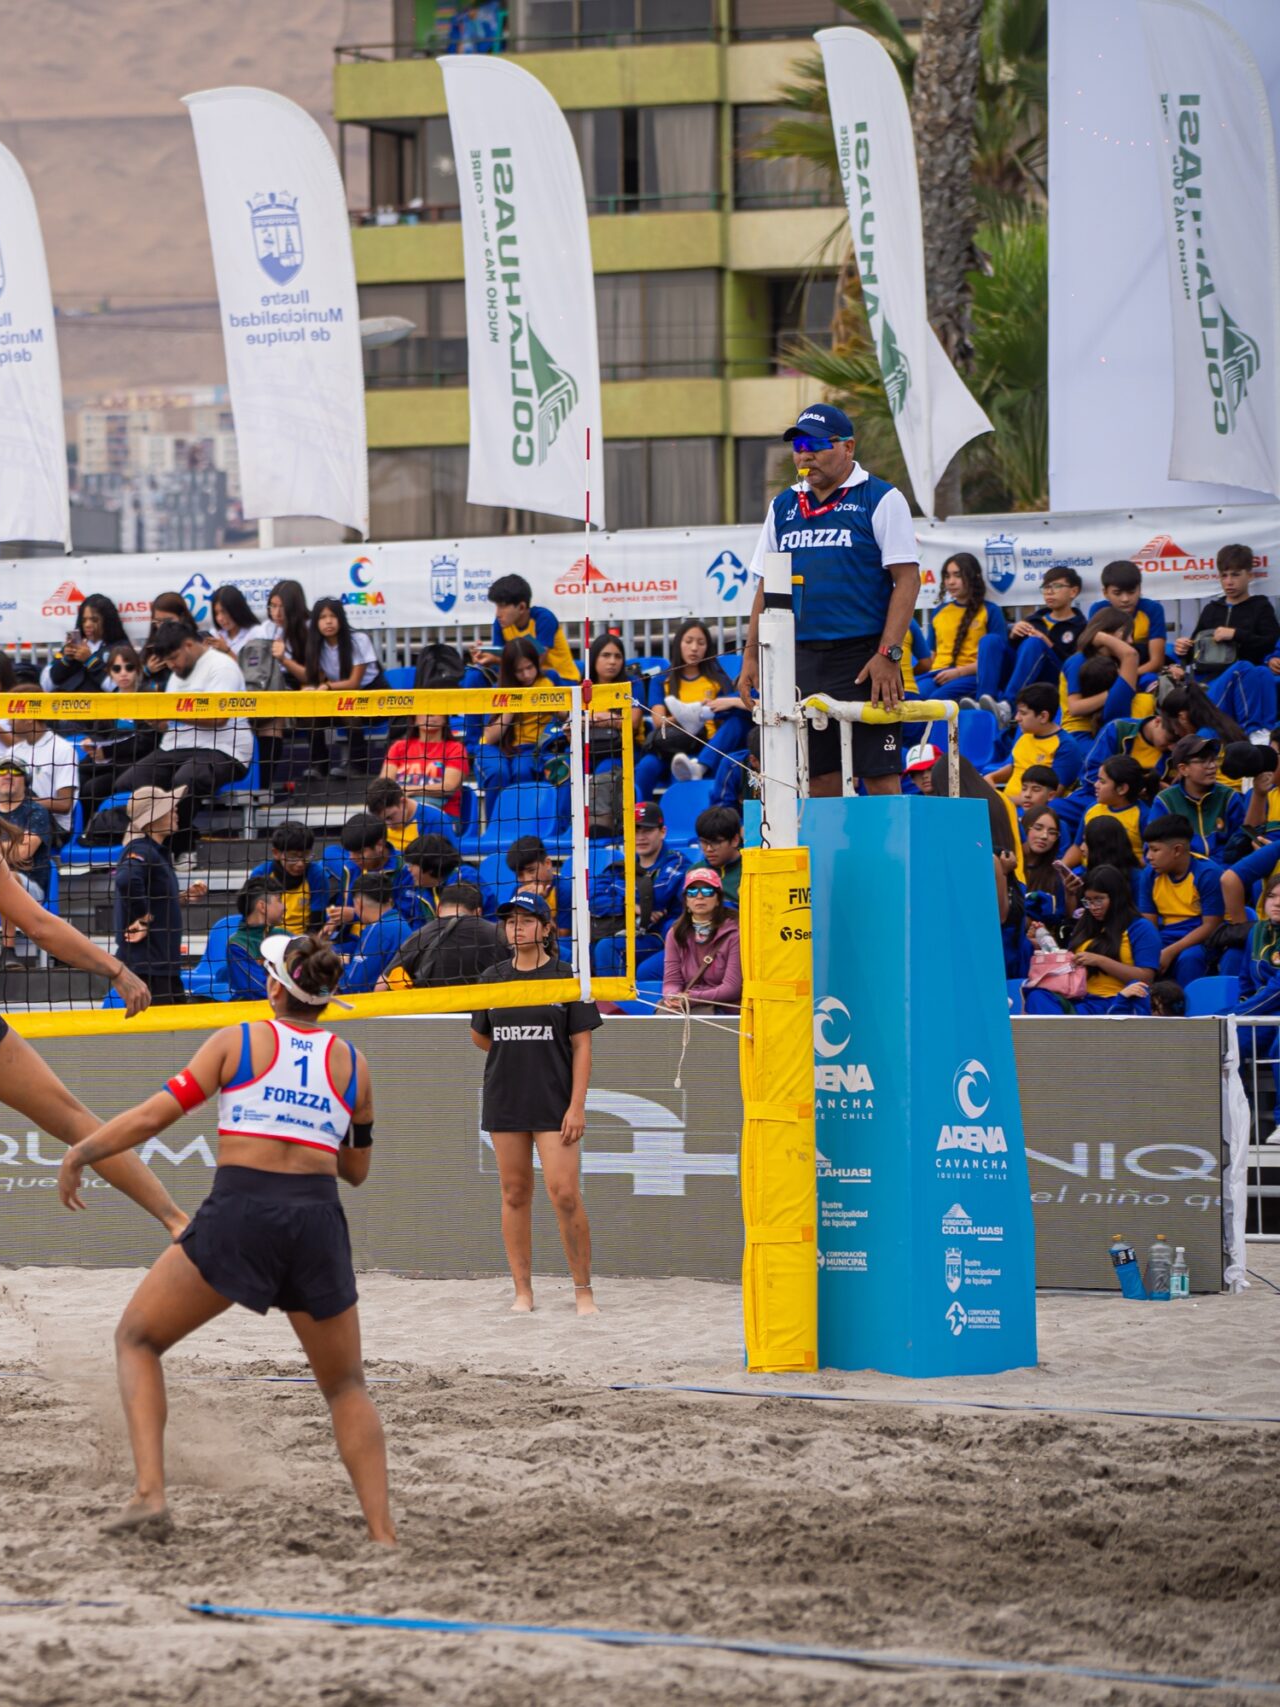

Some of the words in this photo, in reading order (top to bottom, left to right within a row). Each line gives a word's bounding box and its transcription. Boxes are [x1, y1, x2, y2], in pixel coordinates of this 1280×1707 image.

[779, 528, 853, 552] FORZZA
[1022, 547, 1053, 557] Ilustre
[1136, 556, 1269, 573] COLLAHSI
[1024, 573, 1036, 582] de
[7, 699, 28, 714] UK
[176, 697, 195, 712] UK
[337, 696, 356, 711] UK
[492, 693, 509, 707] UK
[789, 887, 811, 904] FIV
[493, 1025, 554, 1042] FORZZA
[291, 1037, 313, 1052] PAR
[294, 1055, 309, 1088] 1
[263, 1086, 332, 1114] FORZZA
[816, 1098, 874, 1109] ANCHA
[842, 1112, 873, 1120] CHILE
[936, 1125, 1008, 1154] ARENA
[936, 1158, 1008, 1170] CAVANCHA
[817, 1168, 871, 1178] LAHUASI
[984, 1173, 1008, 1181] CHILE
[1030, 1184, 1068, 1203] el
[1080, 1187, 1170, 1205] niño
[822, 1219, 831, 1227] de
[942, 1226, 1004, 1236] COLLAHUASI
[826, 1258, 868, 1266] MUNICIPAL
